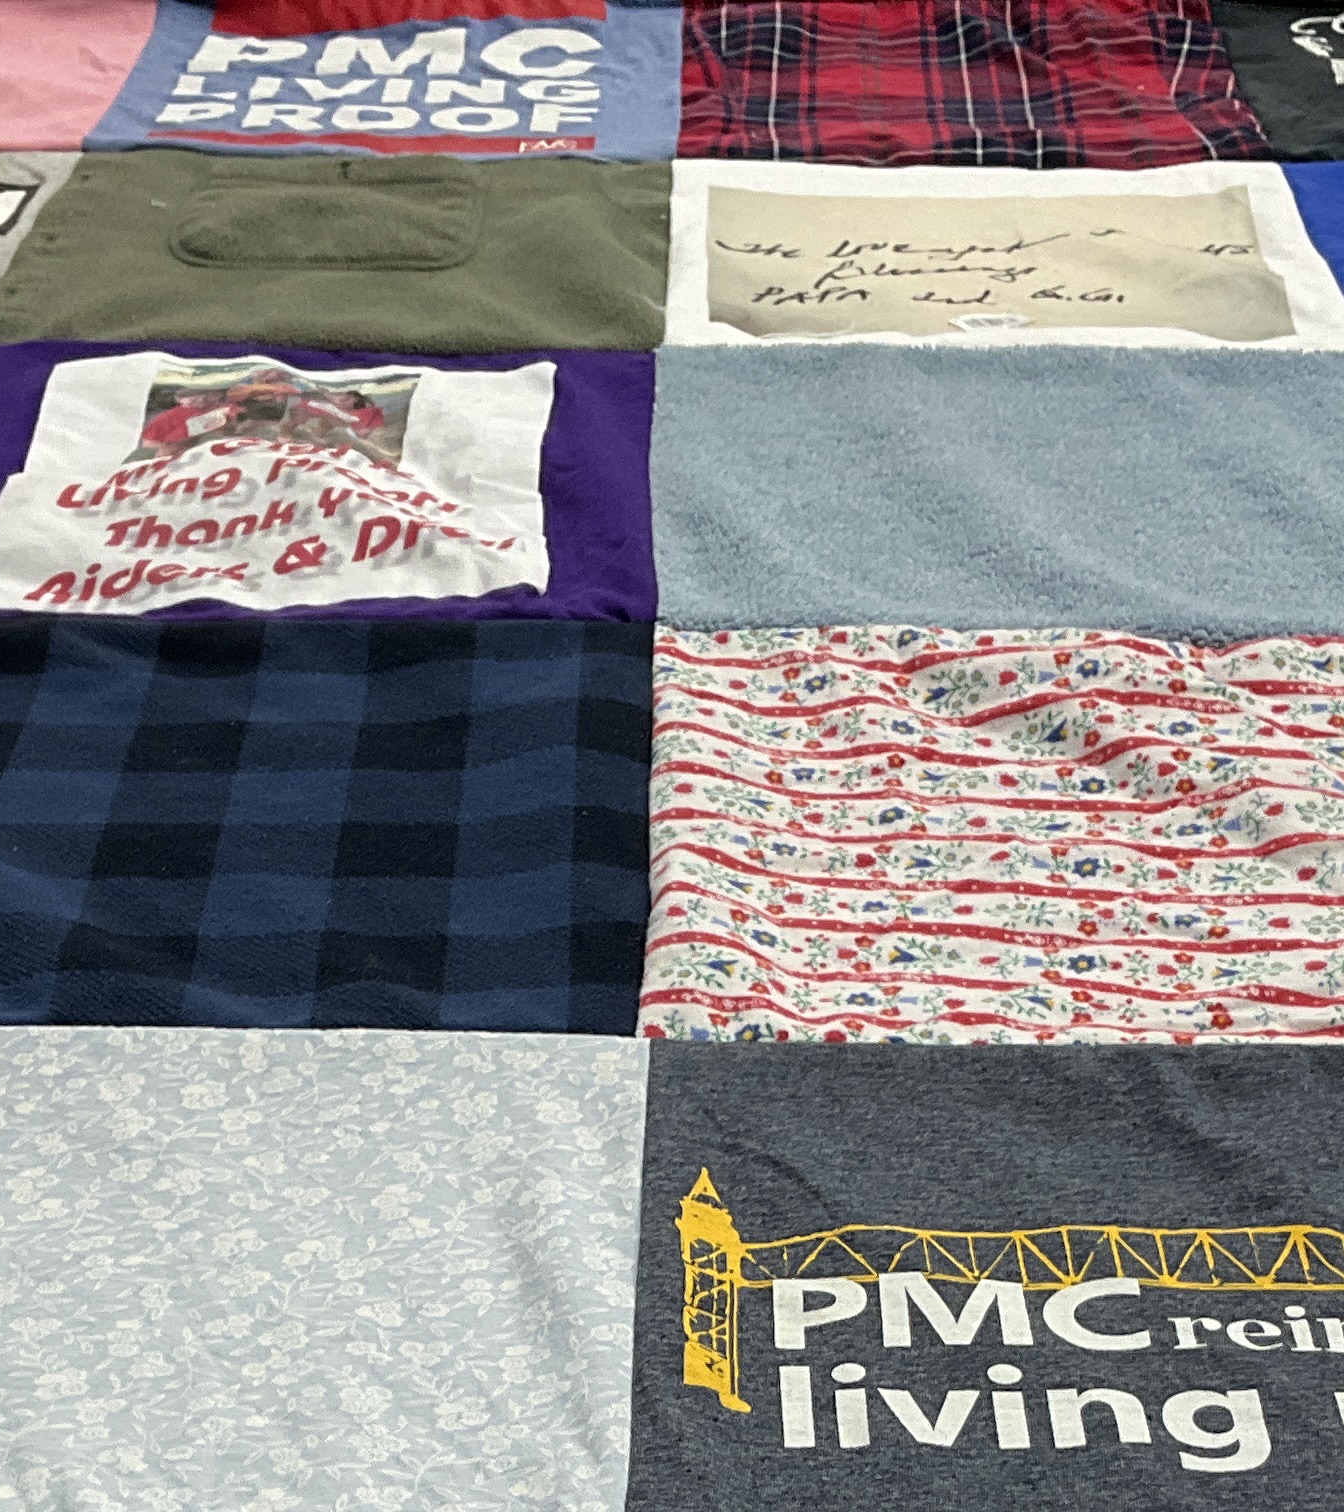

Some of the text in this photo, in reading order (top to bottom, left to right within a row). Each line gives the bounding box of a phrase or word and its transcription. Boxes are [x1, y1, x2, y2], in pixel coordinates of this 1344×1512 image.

[186, 27, 604, 77] PMC
[169, 74, 601, 103] LIVING
[154, 101, 600, 133] PROOF
[750, 285, 871, 306] PAPA
[770, 1271, 1153, 1352] PMC
[780, 1363, 1274, 1473] living
